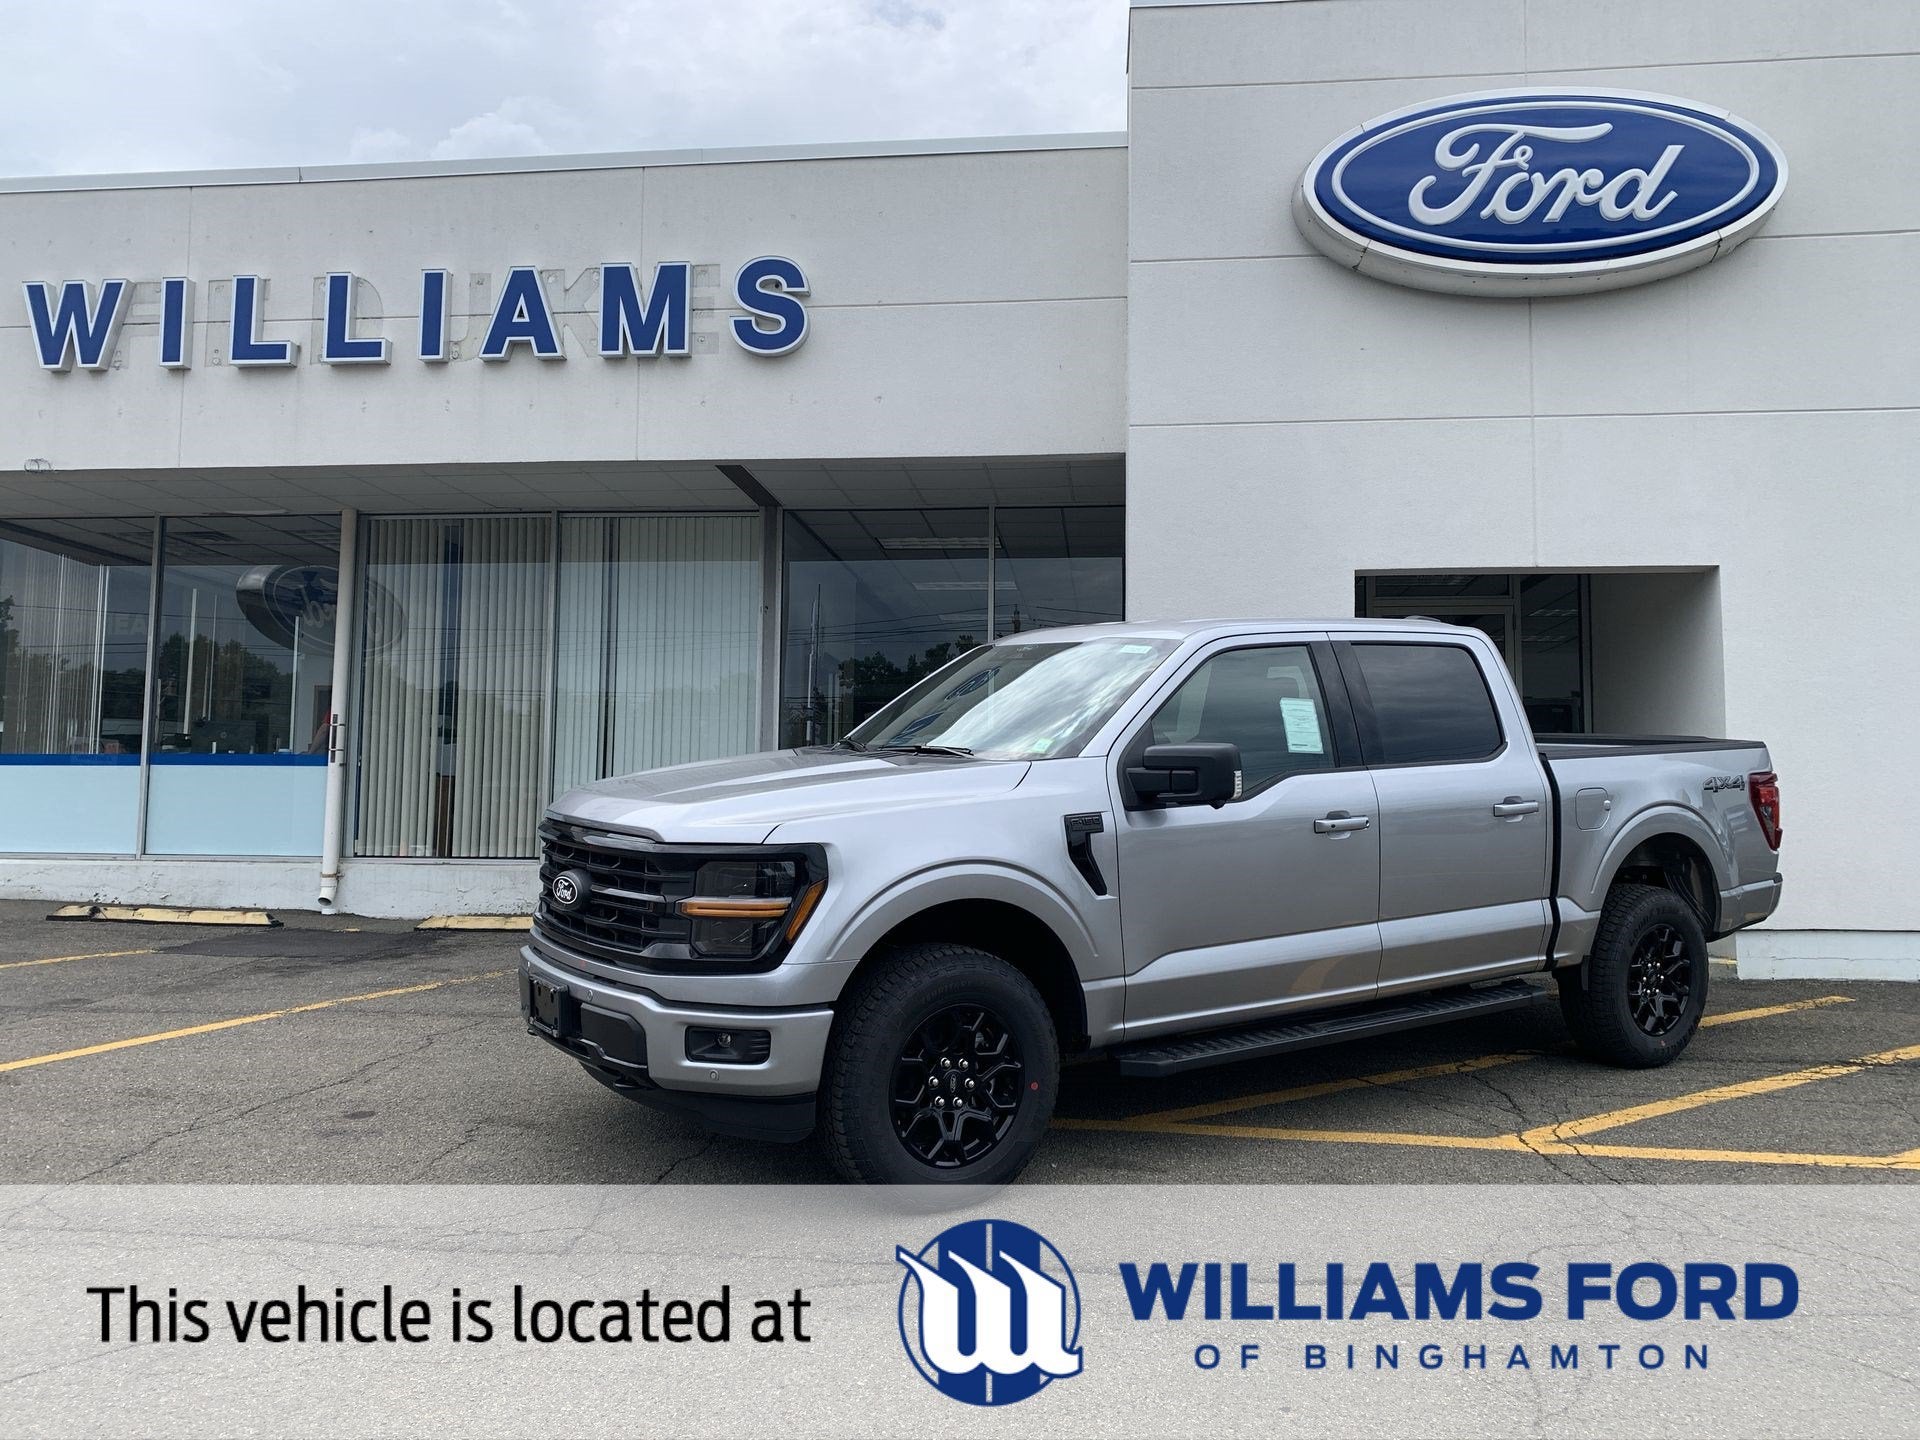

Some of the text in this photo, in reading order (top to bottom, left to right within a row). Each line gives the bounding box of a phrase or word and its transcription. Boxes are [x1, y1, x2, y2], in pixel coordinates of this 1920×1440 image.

[1408, 122, 1685, 227] Ford
[22, 255, 811, 372] WILLIAMS
[556, 879, 573, 901] Ford
